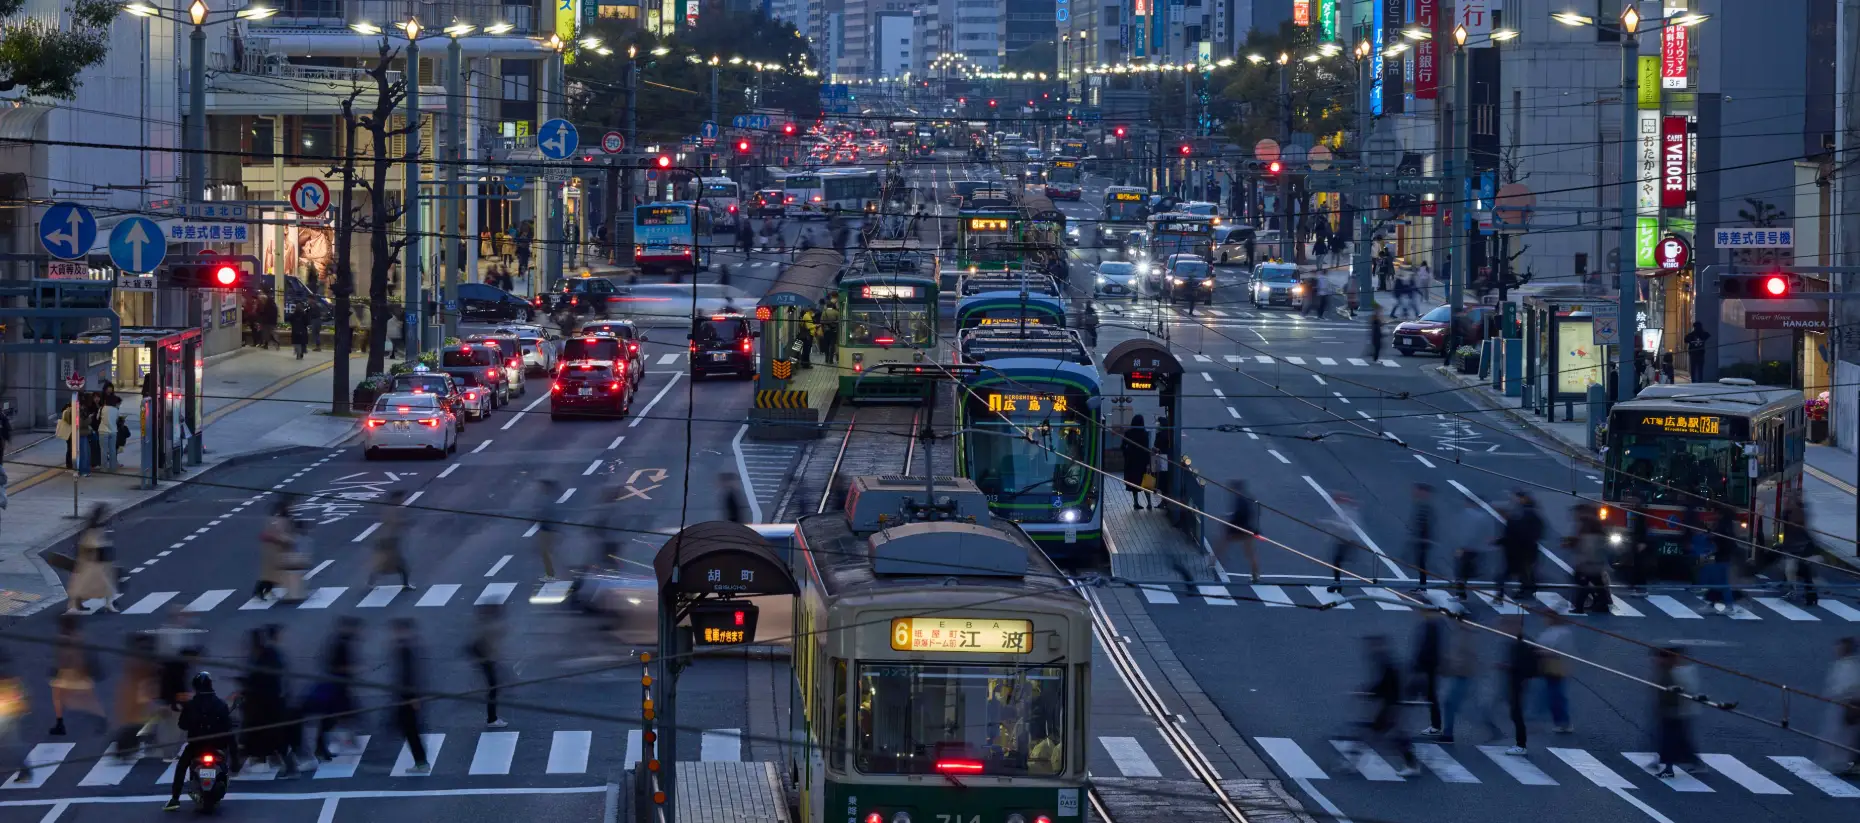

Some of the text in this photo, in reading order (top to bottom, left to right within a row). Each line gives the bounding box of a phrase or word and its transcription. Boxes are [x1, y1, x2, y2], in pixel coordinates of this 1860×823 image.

[1463, 5, 1485, 26] 行
[1389, 28, 1399, 75] SQRE
[1644, 136, 1655, 195] おたからや
[1666, 143, 1683, 191] VELOCE
[171, 225, 247, 241] 時差式信号機
[1641, 223, 1653, 259] レイク
[1717, 231, 1791, 245] 時差式信号機
[1664, 415, 1699, 427] 広島駅
[708, 569, 754, 582] 胡町
[704, 628, 744, 642] 電車がきます
[914, 629, 957, 638] 紙屋町
[959, 630, 1023, 649] 江波
[913, 639, 957, 648] 原爆ドーム前
